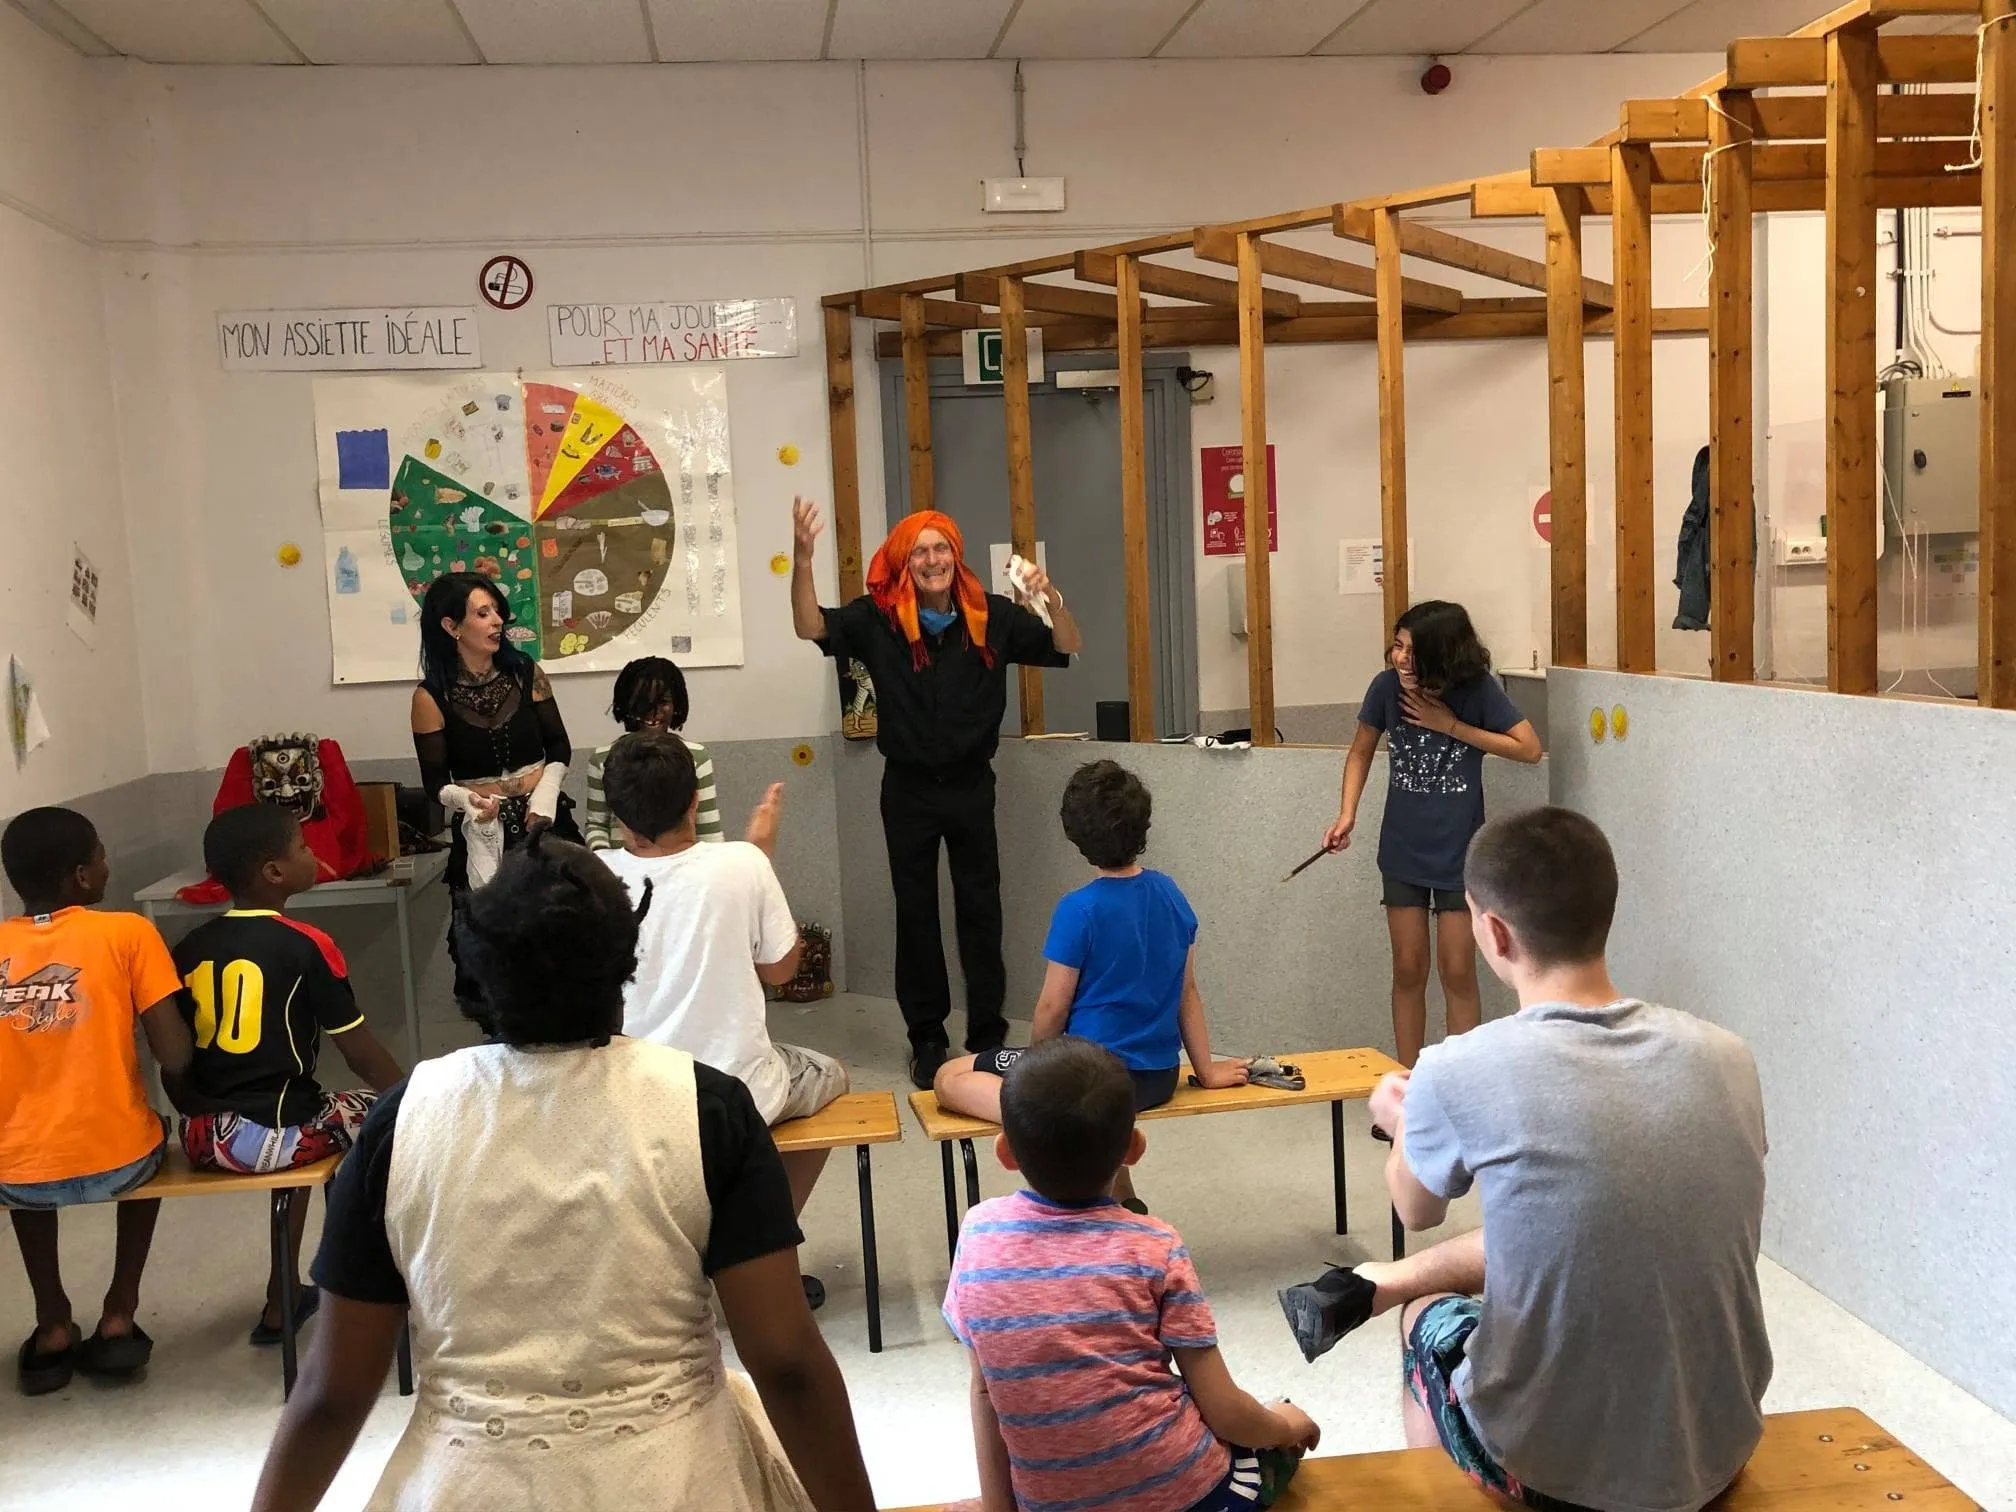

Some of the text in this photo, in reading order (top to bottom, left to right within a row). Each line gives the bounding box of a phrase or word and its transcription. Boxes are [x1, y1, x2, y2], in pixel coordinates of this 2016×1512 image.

[557, 306, 623, 337] POUR
[629, 306, 662, 334] MA
[222, 321, 270, 359] MON
[642, 335, 676, 362] MA
[0, 982, 75, 1004] EAK
[184, 958, 264, 1054] 10
[11, 1000, 78, 1033] Style
